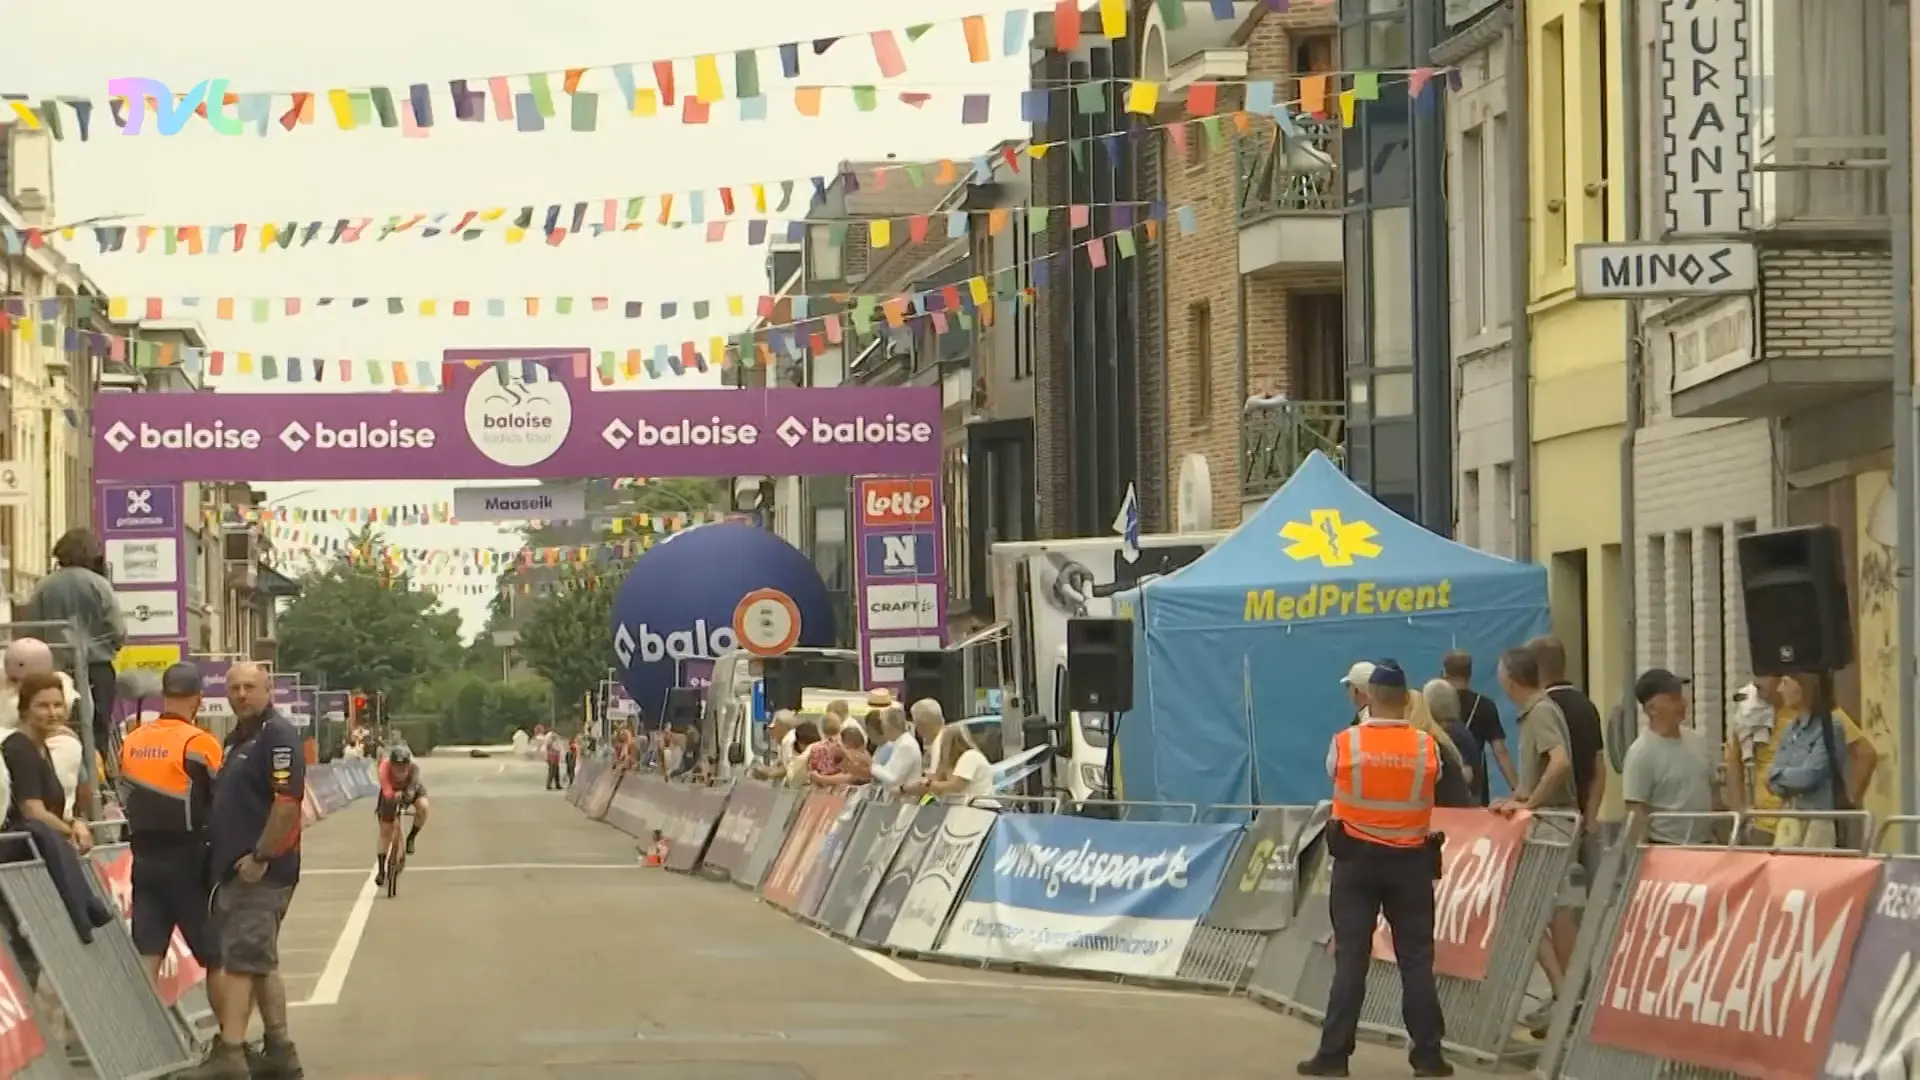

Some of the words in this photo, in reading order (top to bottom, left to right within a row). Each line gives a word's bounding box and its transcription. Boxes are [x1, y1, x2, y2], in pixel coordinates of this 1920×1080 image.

[1684, 0, 1725, 227] URANT
[1602, 248, 1733, 286] MINOS
[140, 419, 262, 450] baloise
[315, 418, 437, 449] baloise
[483, 412, 553, 429] baloise
[638, 416, 758, 447] baloise
[812, 412, 933, 444] baloise
[485, 494, 553, 511] Maaseik
[870, 600, 920, 614] CRAFT
[1244, 577, 1453, 622] MedPrEvent
[129, 744, 170, 759] Politie
[1600, 879, 1855, 1044] FLYERALARM
